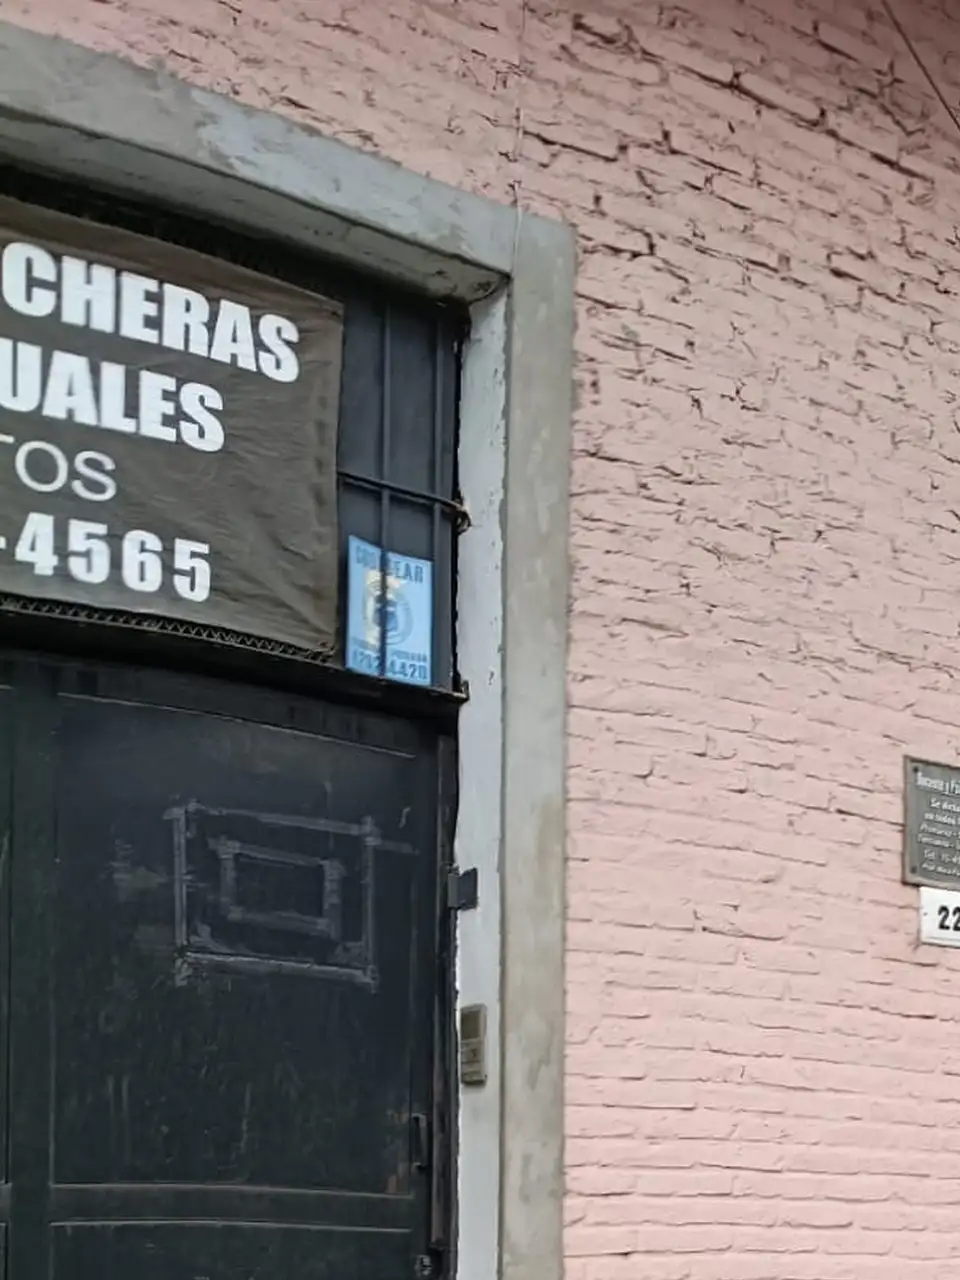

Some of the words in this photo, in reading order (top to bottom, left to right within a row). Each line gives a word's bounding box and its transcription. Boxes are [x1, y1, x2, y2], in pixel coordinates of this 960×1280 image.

[2, 242, 299, 383] CHERAS
[0, 336, 225, 452] UALES
[0, 431, 117, 501] OS
